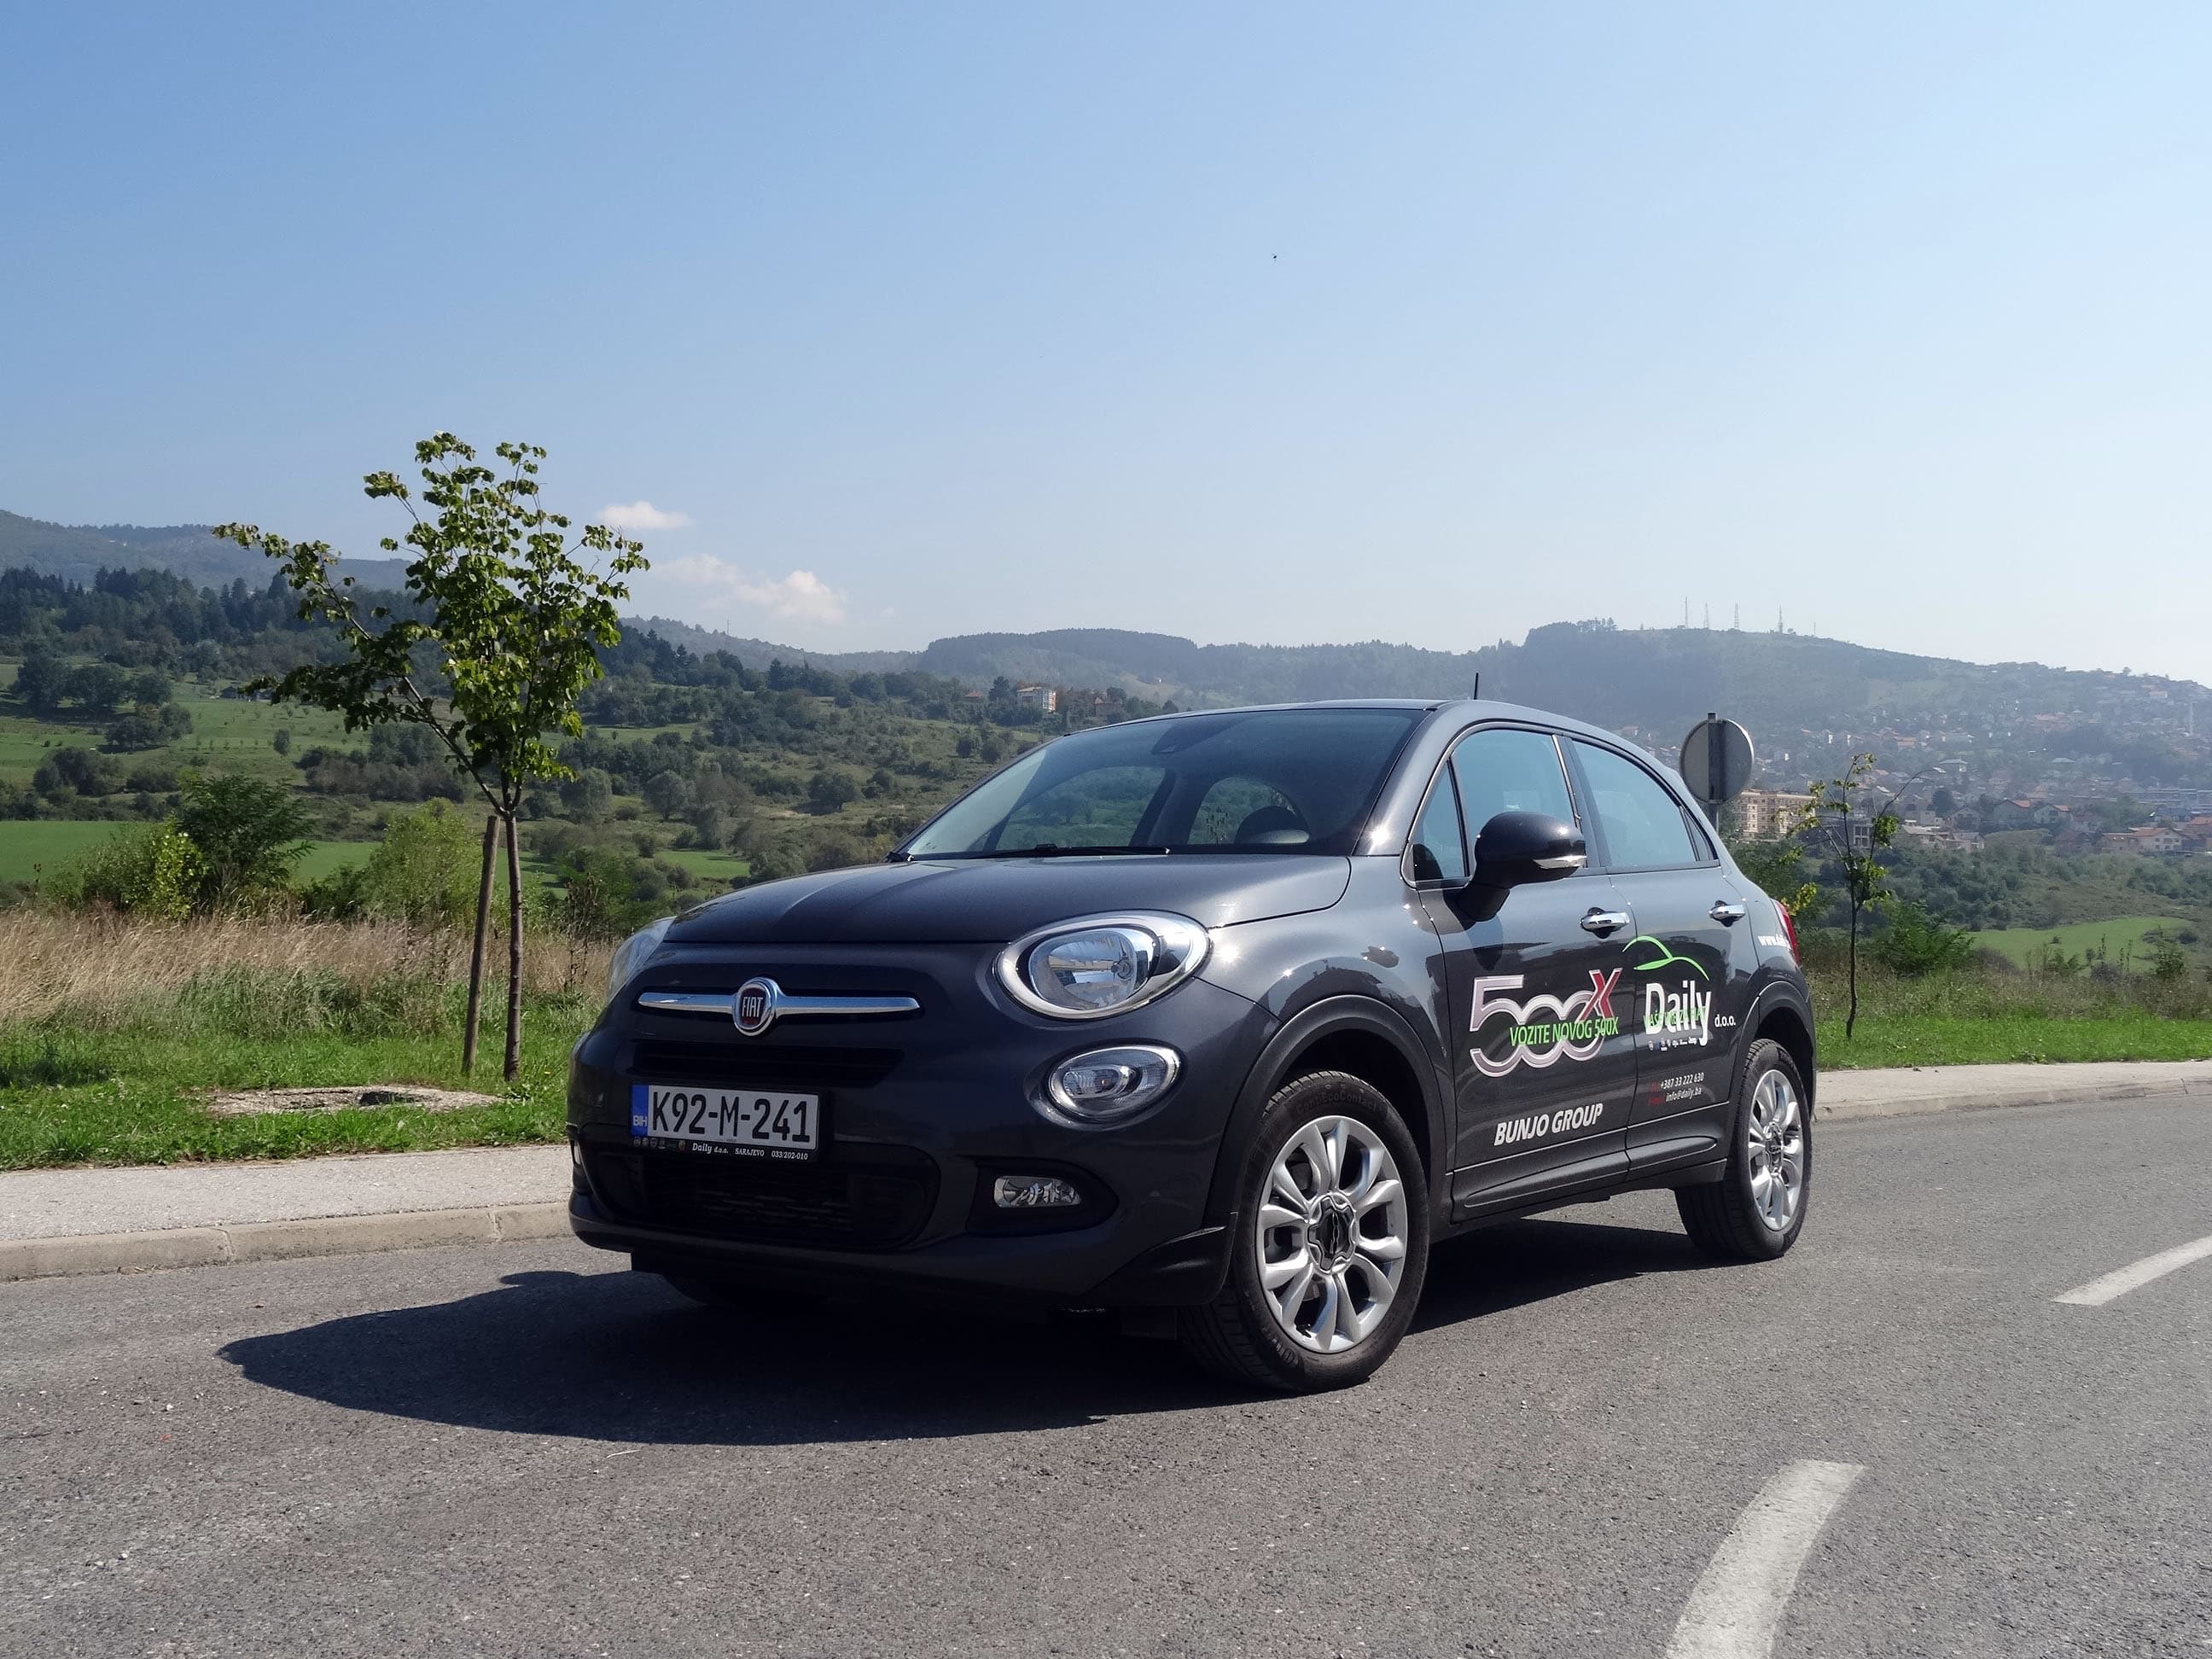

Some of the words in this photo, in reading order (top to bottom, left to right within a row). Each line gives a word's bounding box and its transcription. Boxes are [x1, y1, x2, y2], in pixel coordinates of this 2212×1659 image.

[742, 996, 764, 1018] FIAT
[1645, 980, 1712, 1046] Daily
[1714, 1014, 1736, 1027] d.o.o.
[1510, 1025, 1550, 1046] VOZITE
[1552, 1022, 1592, 1041] NOVOG
[1594, 1016, 1619, 1036] 500X
[632, 1115, 648, 1126] BIH
[652, 1091, 811, 1143] K92-M-241
[1493, 1115, 1550, 1146] BUNJO
[1551, 1103, 1603, 1133] GROUP
[692, 1143, 712, 1155] Daily
[735, 1148, 765, 1156] SARAJEVO
[771, 1150, 808, 1160] 033/202-010
